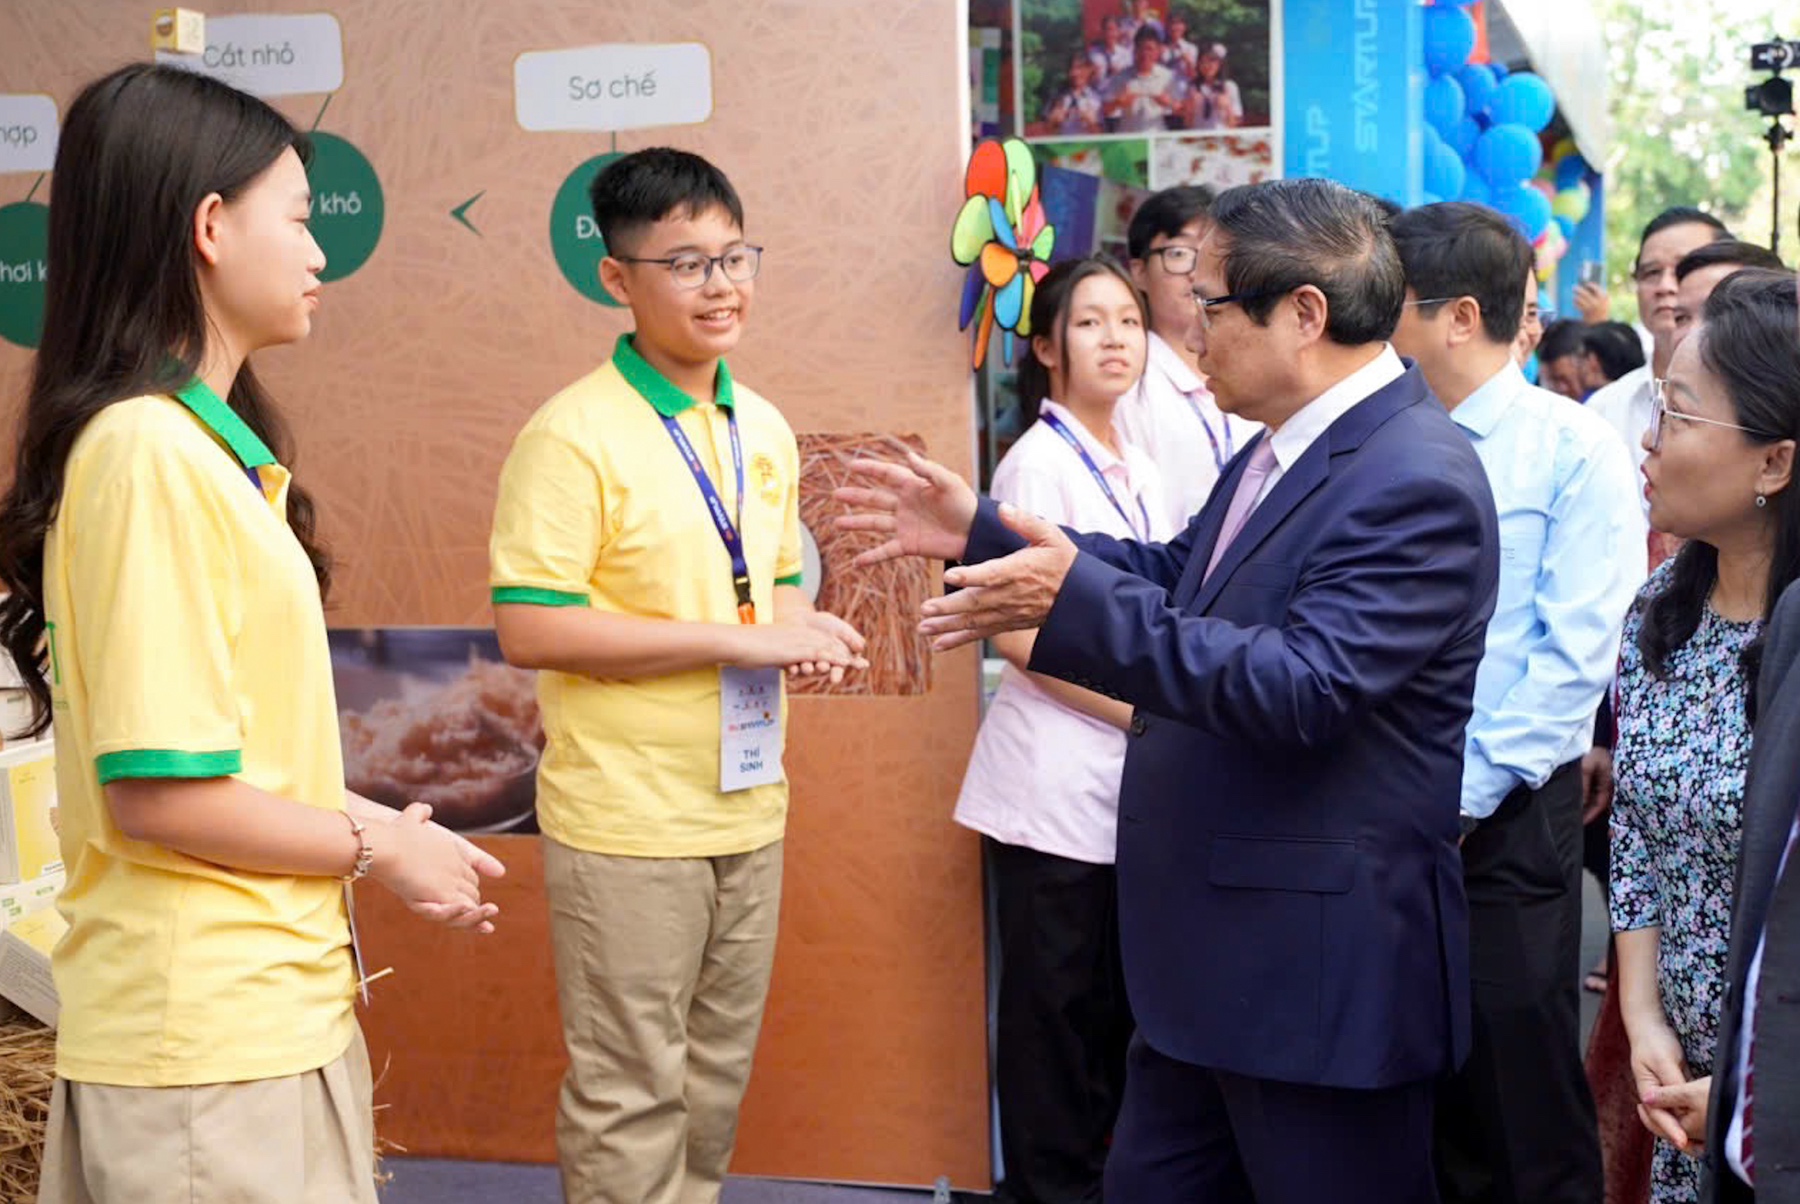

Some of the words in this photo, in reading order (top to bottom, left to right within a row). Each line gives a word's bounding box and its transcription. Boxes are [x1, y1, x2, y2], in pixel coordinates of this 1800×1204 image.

[202, 42, 246, 68] Cát
[252, 42, 294, 66] nhỏ
[569, 75, 602, 101] Sơ
[609, 69, 657, 98] chế
[320, 191, 362, 216] khô
[740, 760, 763, 773] SINH
